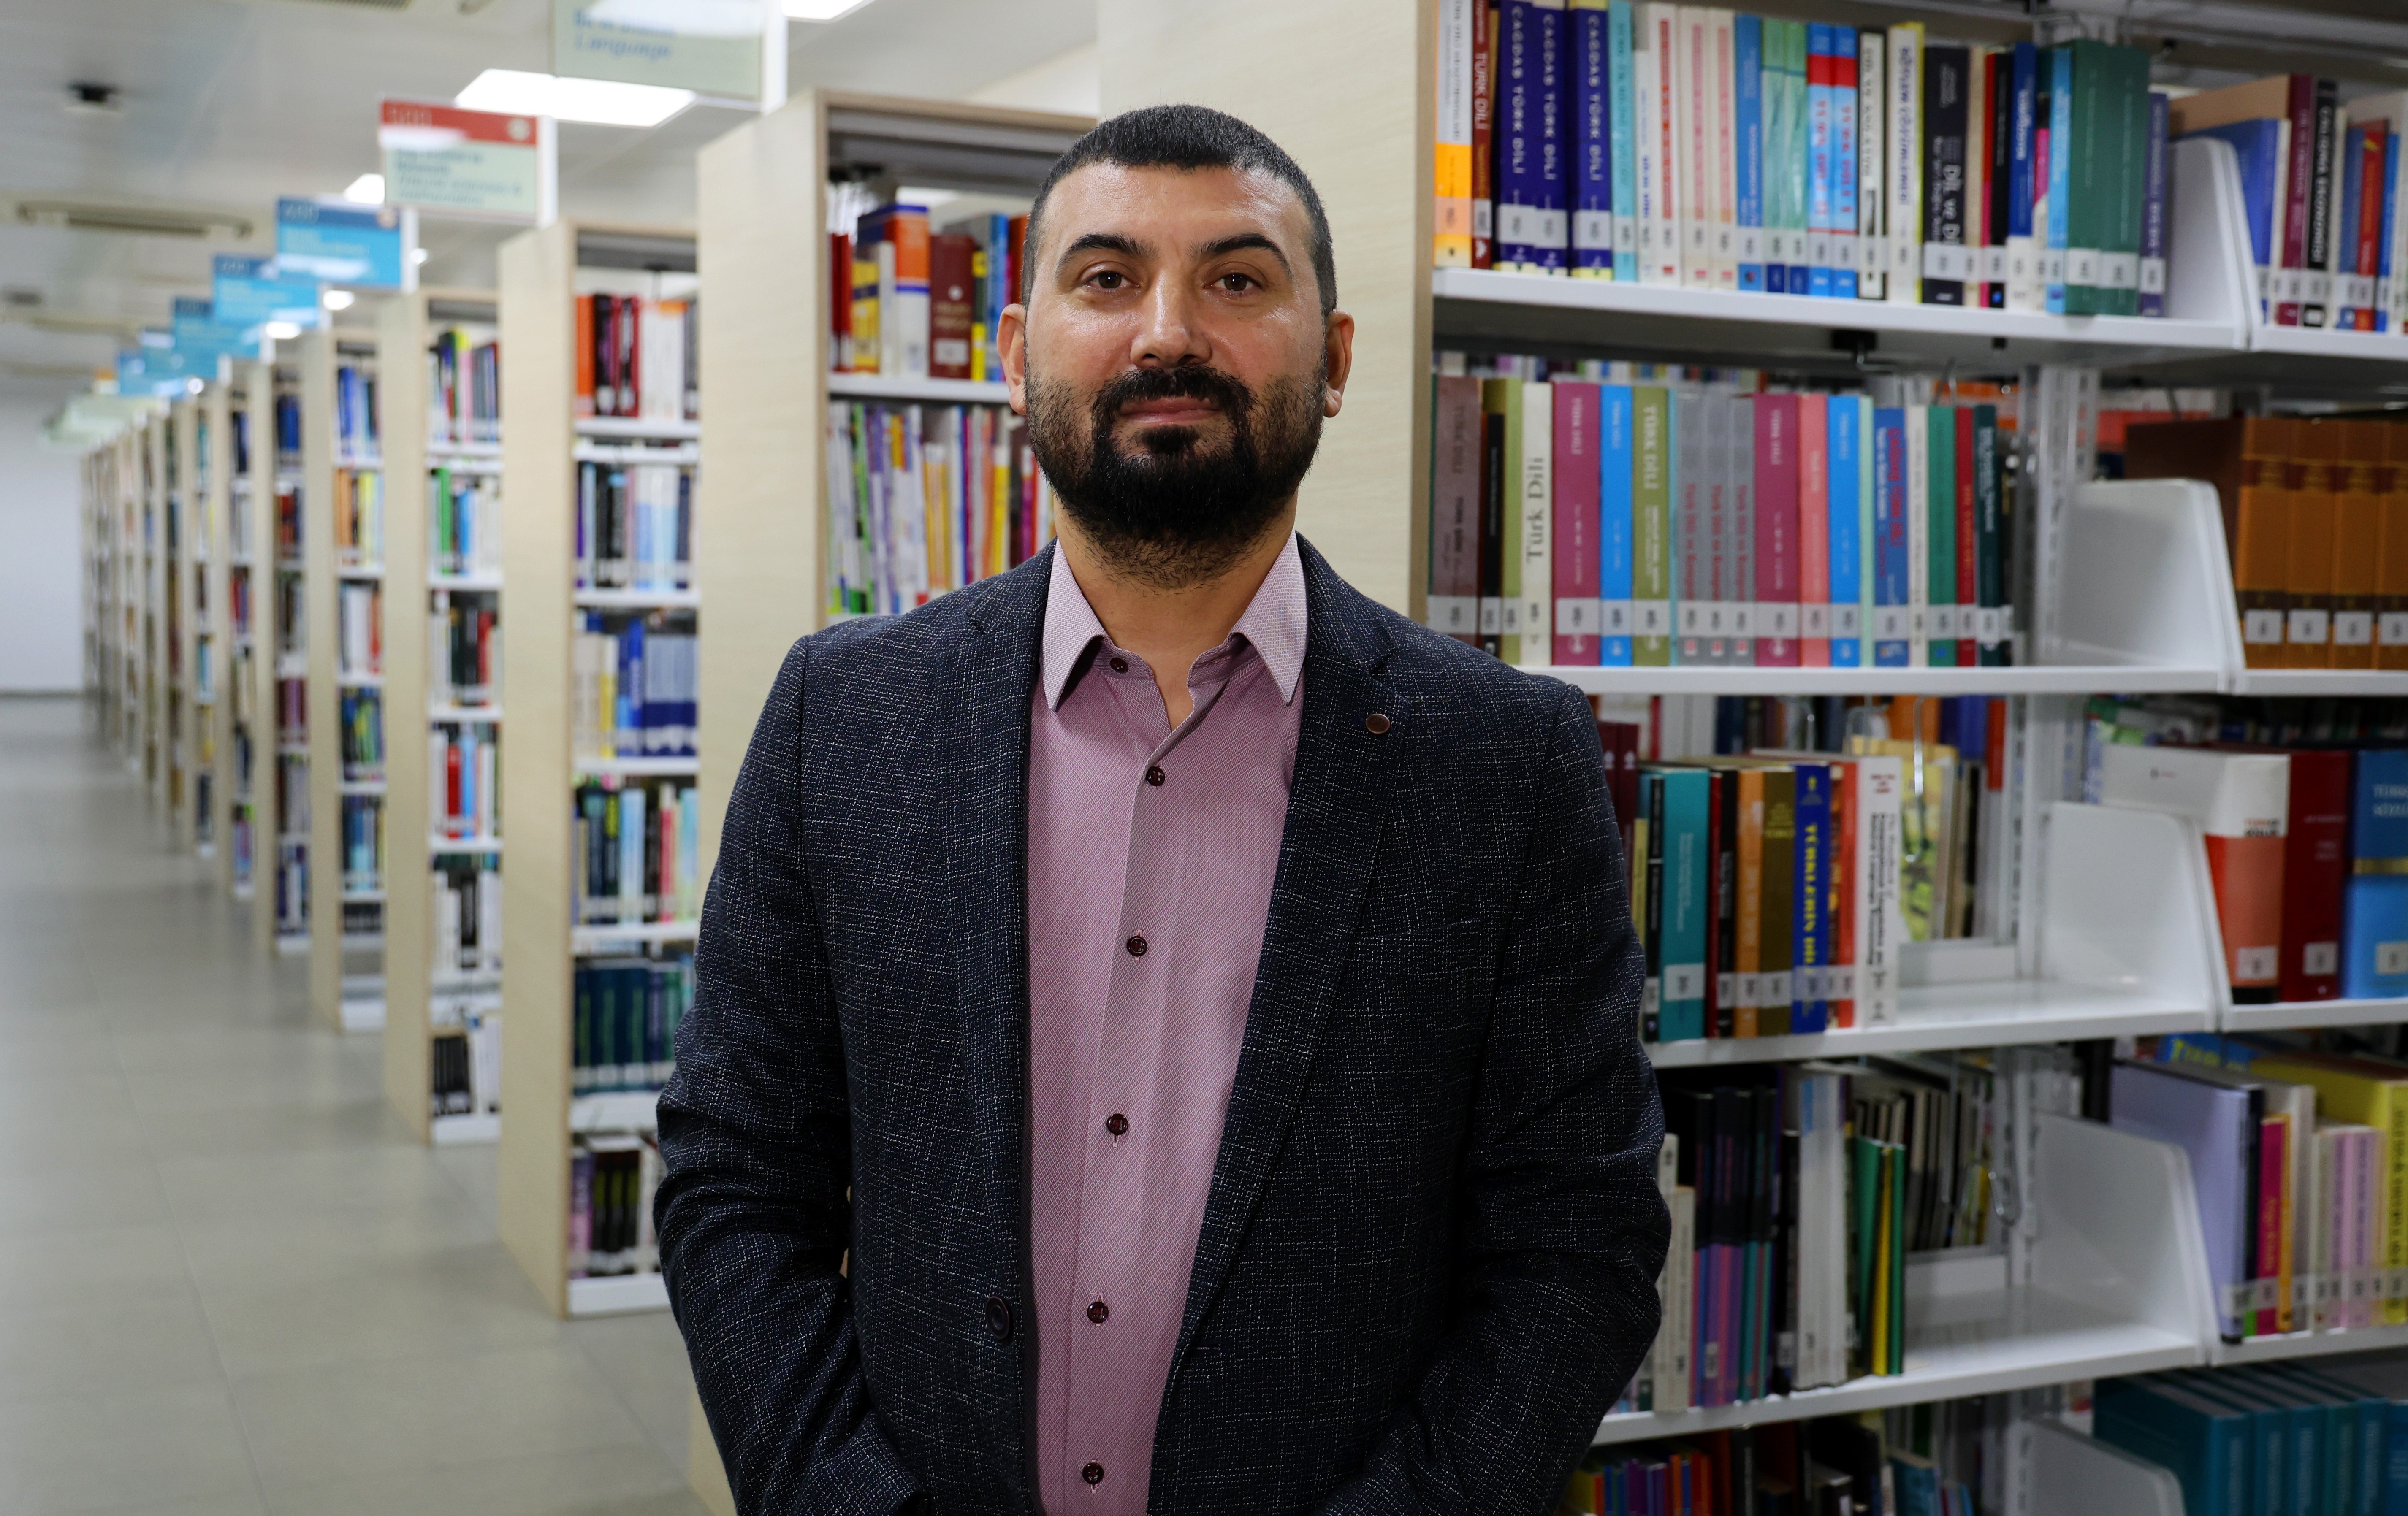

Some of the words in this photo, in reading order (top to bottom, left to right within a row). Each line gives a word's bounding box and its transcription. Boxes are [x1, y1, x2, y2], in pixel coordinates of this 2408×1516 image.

[1944, 163, 1962, 194] DİL
[1944, 198, 1958, 220] ve
[1643, 406, 1658, 451] TÜRK
[1527, 456, 1544, 500] Dili
[1644, 453, 1659, 490] DİLİ
[1526, 508, 1544, 563] Türk
